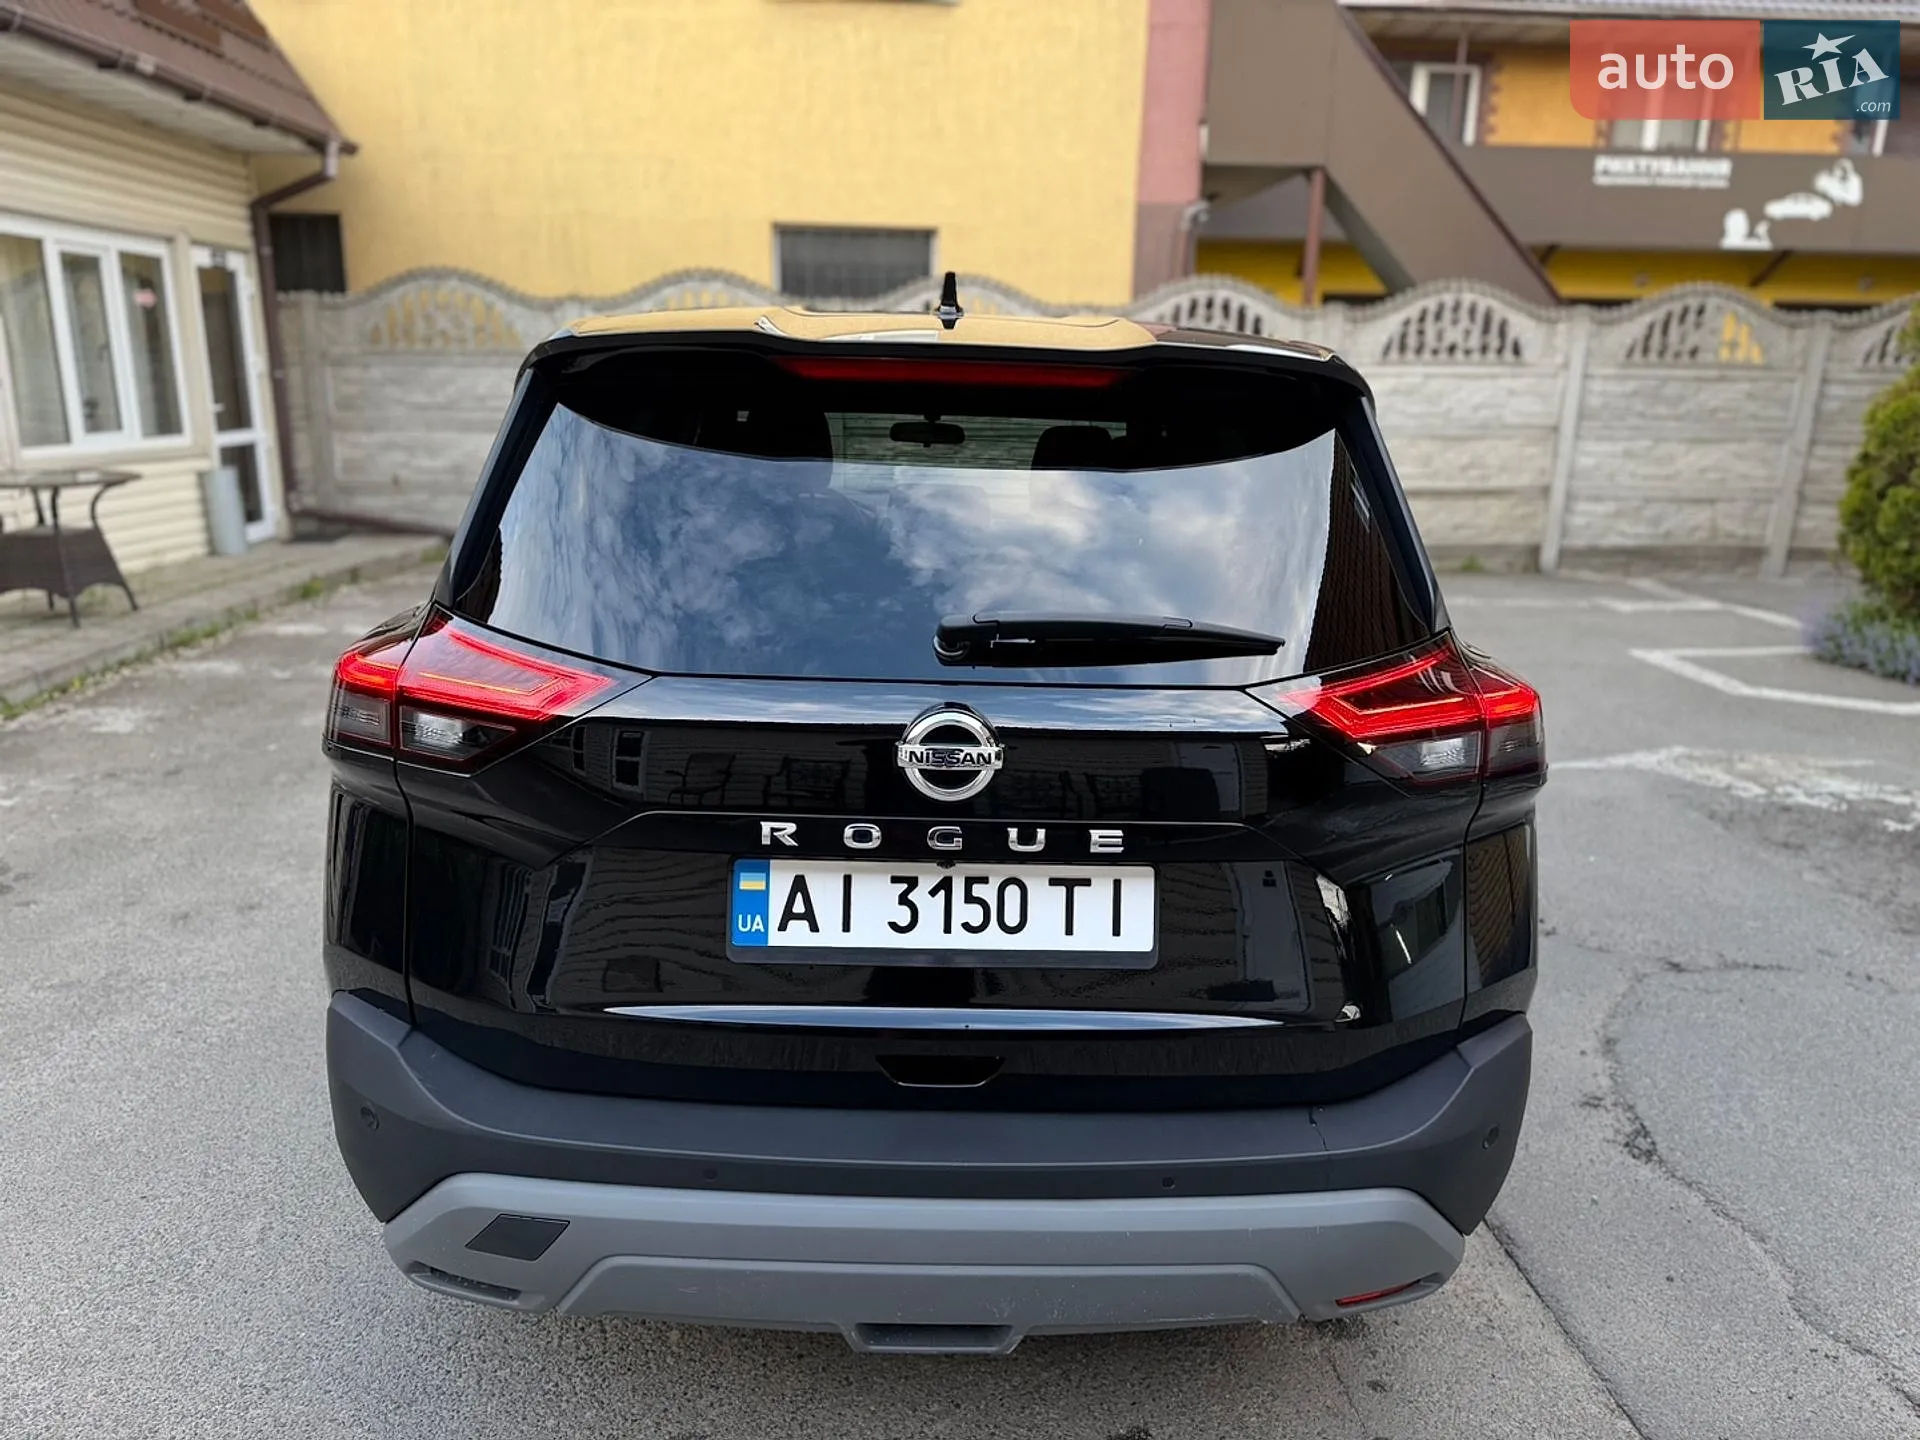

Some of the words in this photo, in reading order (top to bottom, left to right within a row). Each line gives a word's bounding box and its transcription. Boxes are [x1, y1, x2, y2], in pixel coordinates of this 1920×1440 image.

[909, 749, 993, 767] NISSAN
[760, 821, 1125, 854] ROGUE
[777, 874, 852, 933] AI
[887, 875, 1028, 935] 3150
[1048, 877, 1122, 937] TI
[738, 913, 765, 932] UA
